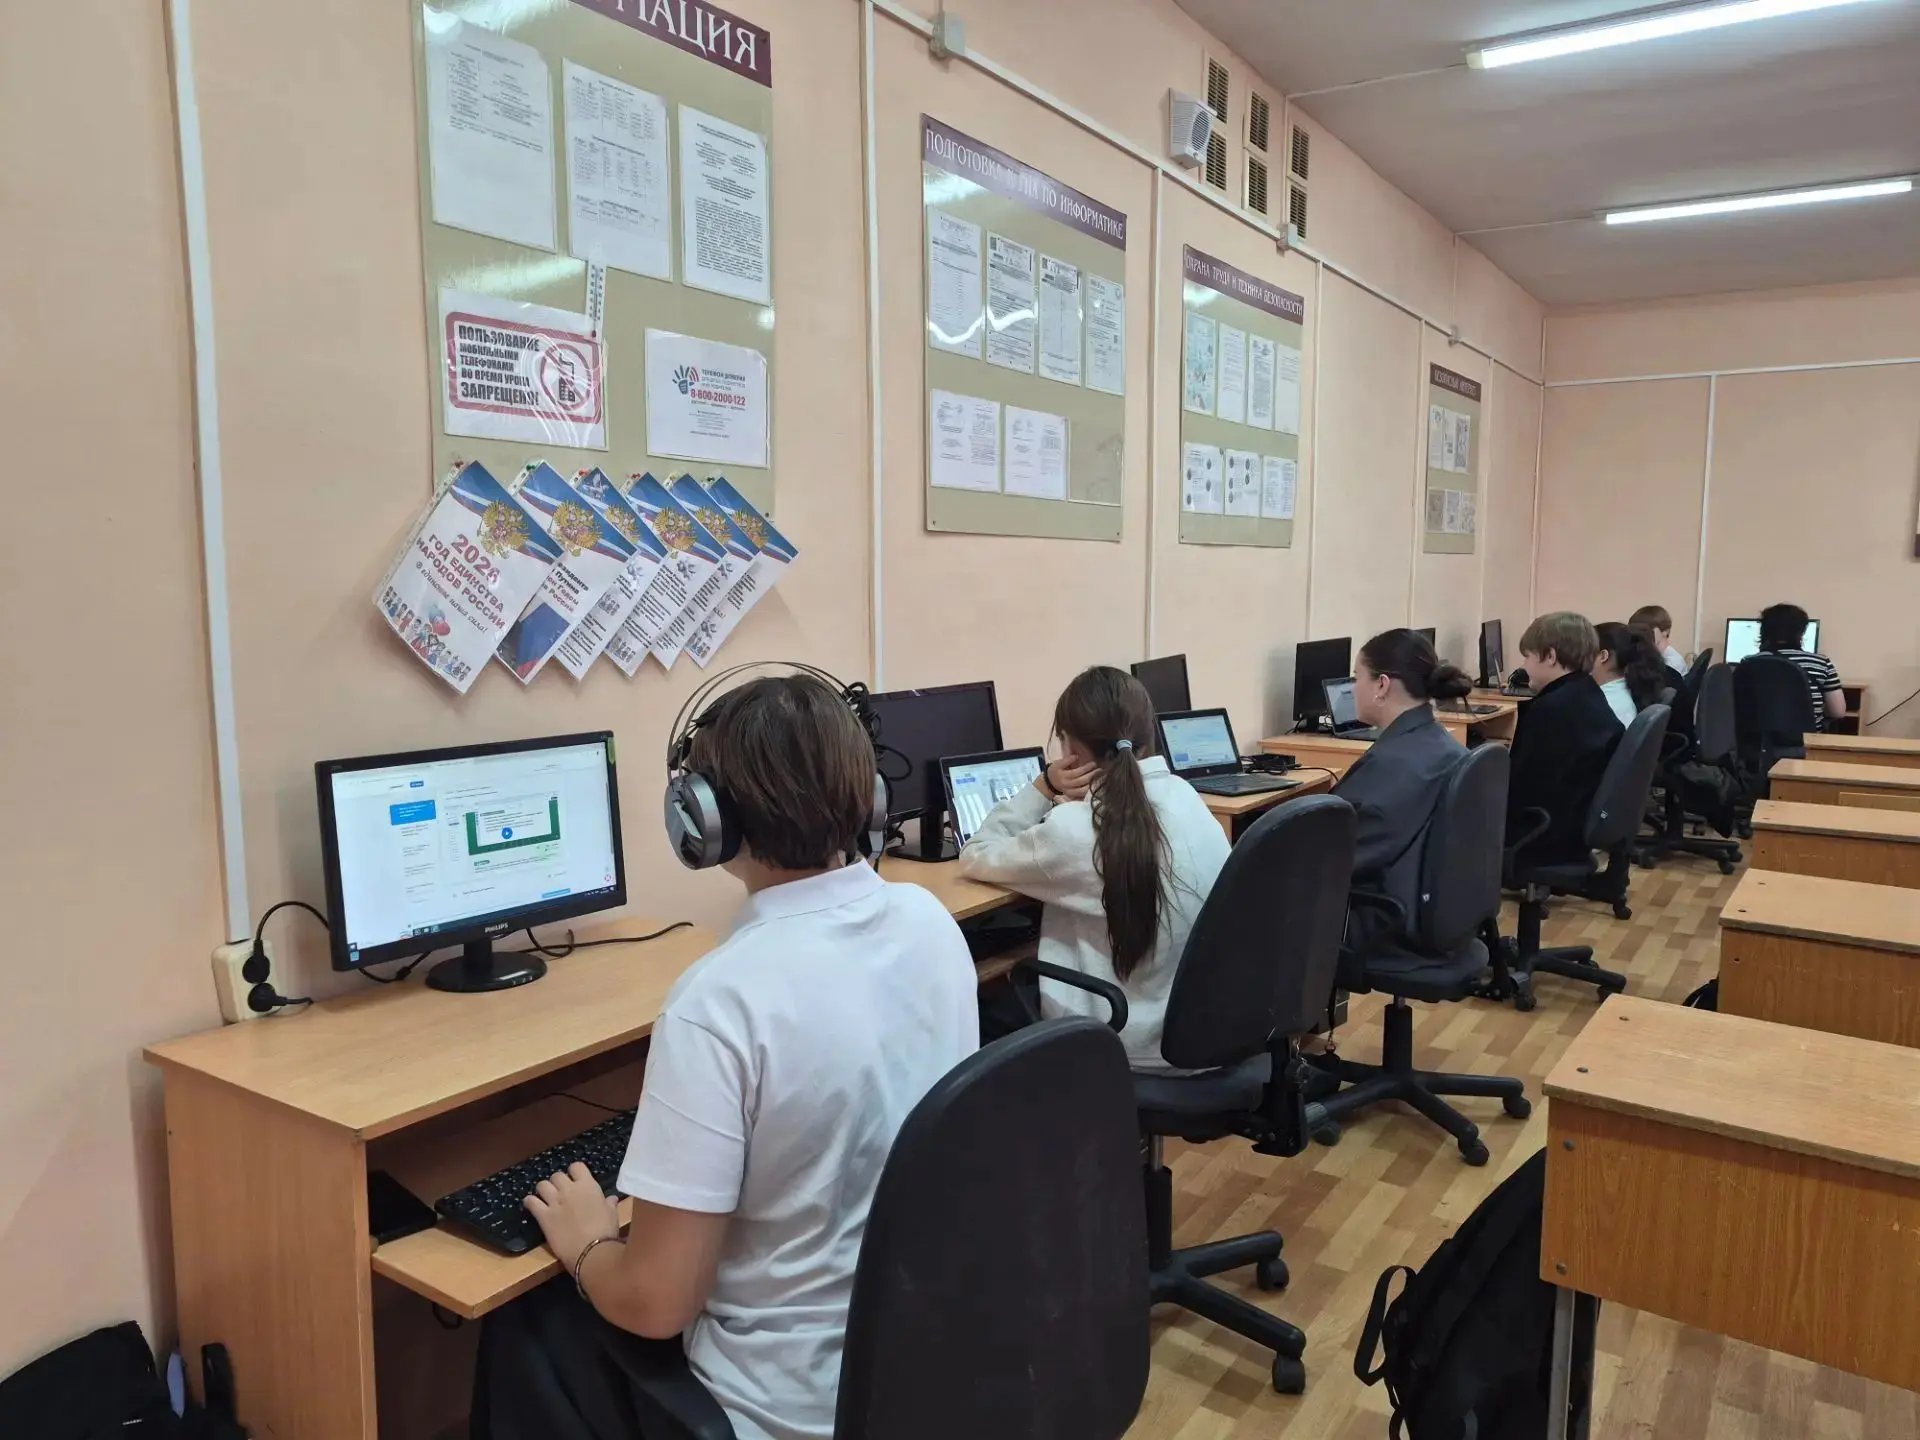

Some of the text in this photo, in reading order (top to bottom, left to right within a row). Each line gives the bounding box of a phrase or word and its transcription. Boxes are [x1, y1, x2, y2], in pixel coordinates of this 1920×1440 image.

[926, 130, 1000, 180] ПОДГОТОВКА
[1042, 184, 1057, 208] ПО
[1060, 194, 1124, 240] ИНФОРМАТИКЕ
[458, 325, 540, 352] ПОЛЬЗОВАНИЕ
[460, 342, 519, 361] МОБИЛЬНЫМИ
[460, 354, 514, 372] ТЕЛЕФОНАМИ
[461, 368, 473, 379] ВО
[474, 369, 503, 383] ВРЕМЯ
[460, 381, 540, 406] ЗАПРЕЩЕНО!
[416, 537, 506, 630] НАРОДОВ РОССИИ
[429, 534, 504, 613] ГОД ЕДИНСТВА
